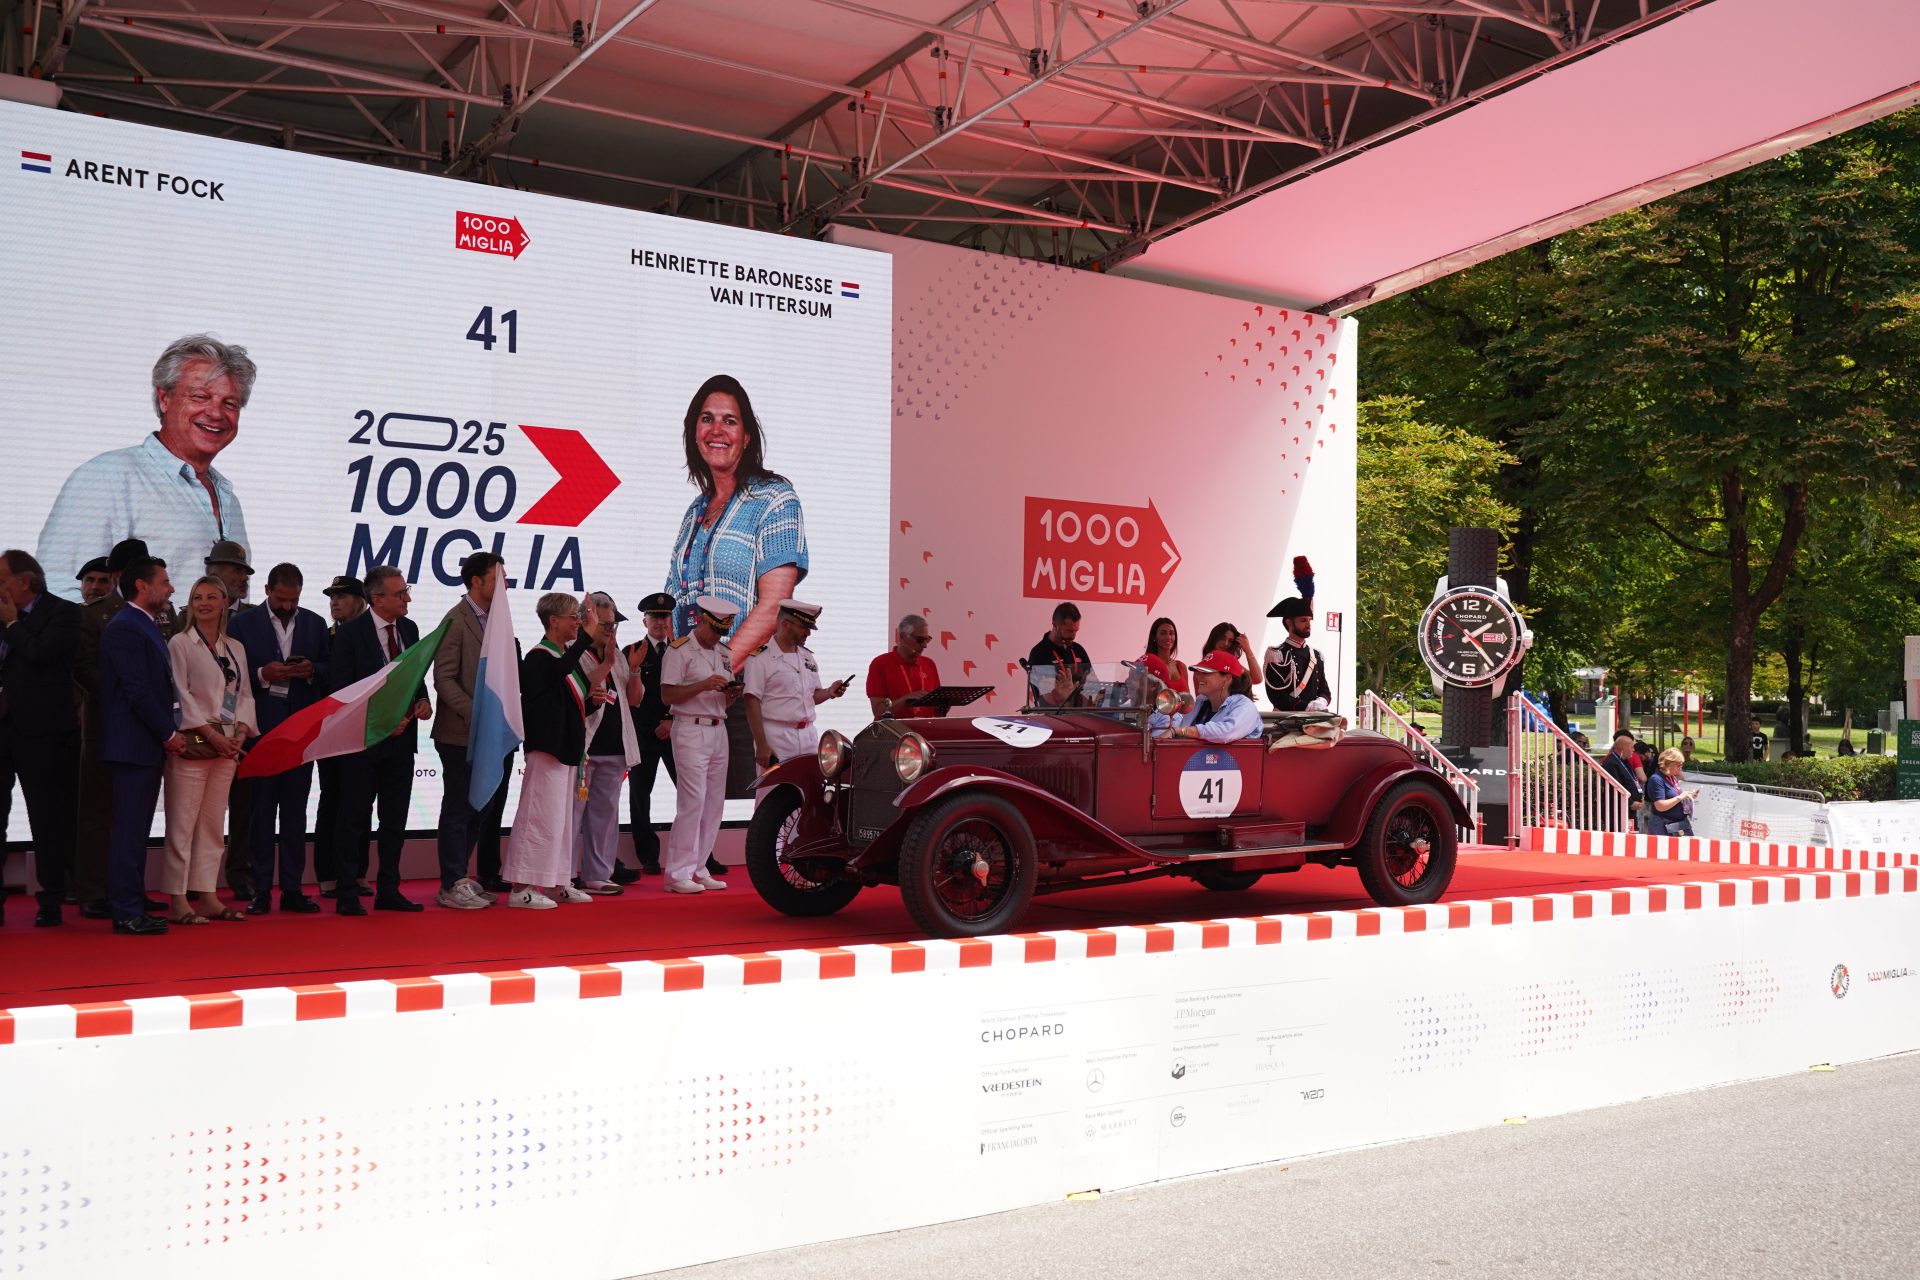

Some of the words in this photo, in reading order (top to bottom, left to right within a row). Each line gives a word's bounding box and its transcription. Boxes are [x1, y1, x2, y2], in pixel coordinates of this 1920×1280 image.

[65, 158, 150, 190] ARENT
[157, 174, 225, 201] FOCK
[463, 216, 510, 235] 1000
[459, 234, 514, 253] MIGLIA
[631, 249, 729, 279] HENRIETTE
[735, 265, 833, 294] BARONESSE
[710, 286, 743, 306] VAN
[750, 292, 832, 318] ITTERSUM
[466, 306, 517, 353] 41
[347, 455, 517, 522] 1000
[1040, 509, 1139, 548] 1000
[345, 523, 585, 592] MIGLIA
[1032, 557, 1145, 595] MIGLIA
[1462, 599, 1480, 611] 12
[1462, 663, 1476, 674] 6
[993, 723, 1028, 734] 41
[415, 769, 437, 777] OTO
[1198, 777, 1224, 803] 41
[981, 1023, 1064, 1042] CHOPARD
[982, 1078, 1042, 1093] VREDESTEIN
